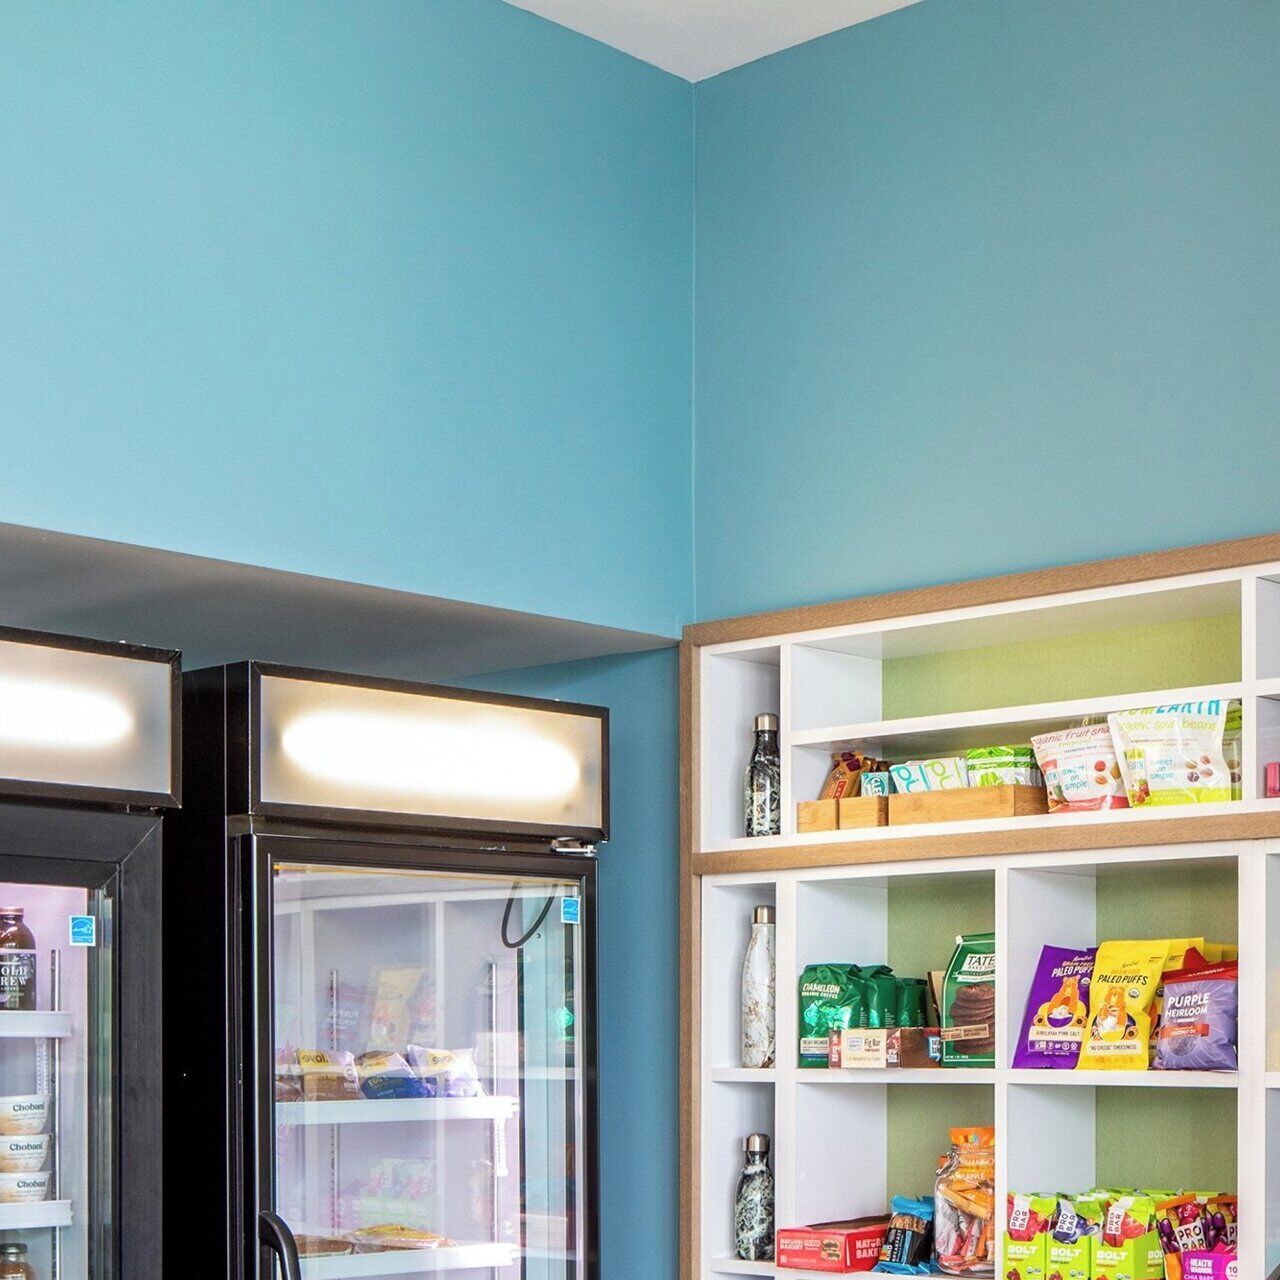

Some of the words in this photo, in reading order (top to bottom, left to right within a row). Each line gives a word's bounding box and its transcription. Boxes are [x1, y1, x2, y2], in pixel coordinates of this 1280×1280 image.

[1182, 720, 1215, 729] beans
[1066, 729, 1089, 739] fruit
[1052, 967, 1074, 977] PALEO
[1097, 975, 1121, 984] PALEO
[1122, 976, 1148, 985] PUFFS
[803, 982, 840, 994] CHAMELEON
[1168, 992, 1210, 1005] PURPLE
[1164, 1005, 1208, 1018] HEIRLOOM
[13, 1103, 44, 1112] Chobani
[9, 1142, 43, 1151] Chobani
[17, 1180, 46, 1188] Chobani
[1011, 1211, 1021, 1228] PRO
[1019, 1211, 1028, 1228] BAR
[1059, 1212, 1068, 1232] PRO
[1066, 1214, 1077, 1232] BAR
[1178, 1225, 1202, 1241] PRO
[1007, 1245, 1038, 1254] BOLT
[1181, 1239, 1205, 1250] BAR
[1050, 1248, 1082, 1257] BOLT
[1096, 1250, 1128, 1260] BOLT
[1190, 1259, 1213, 1268] HEALTH
